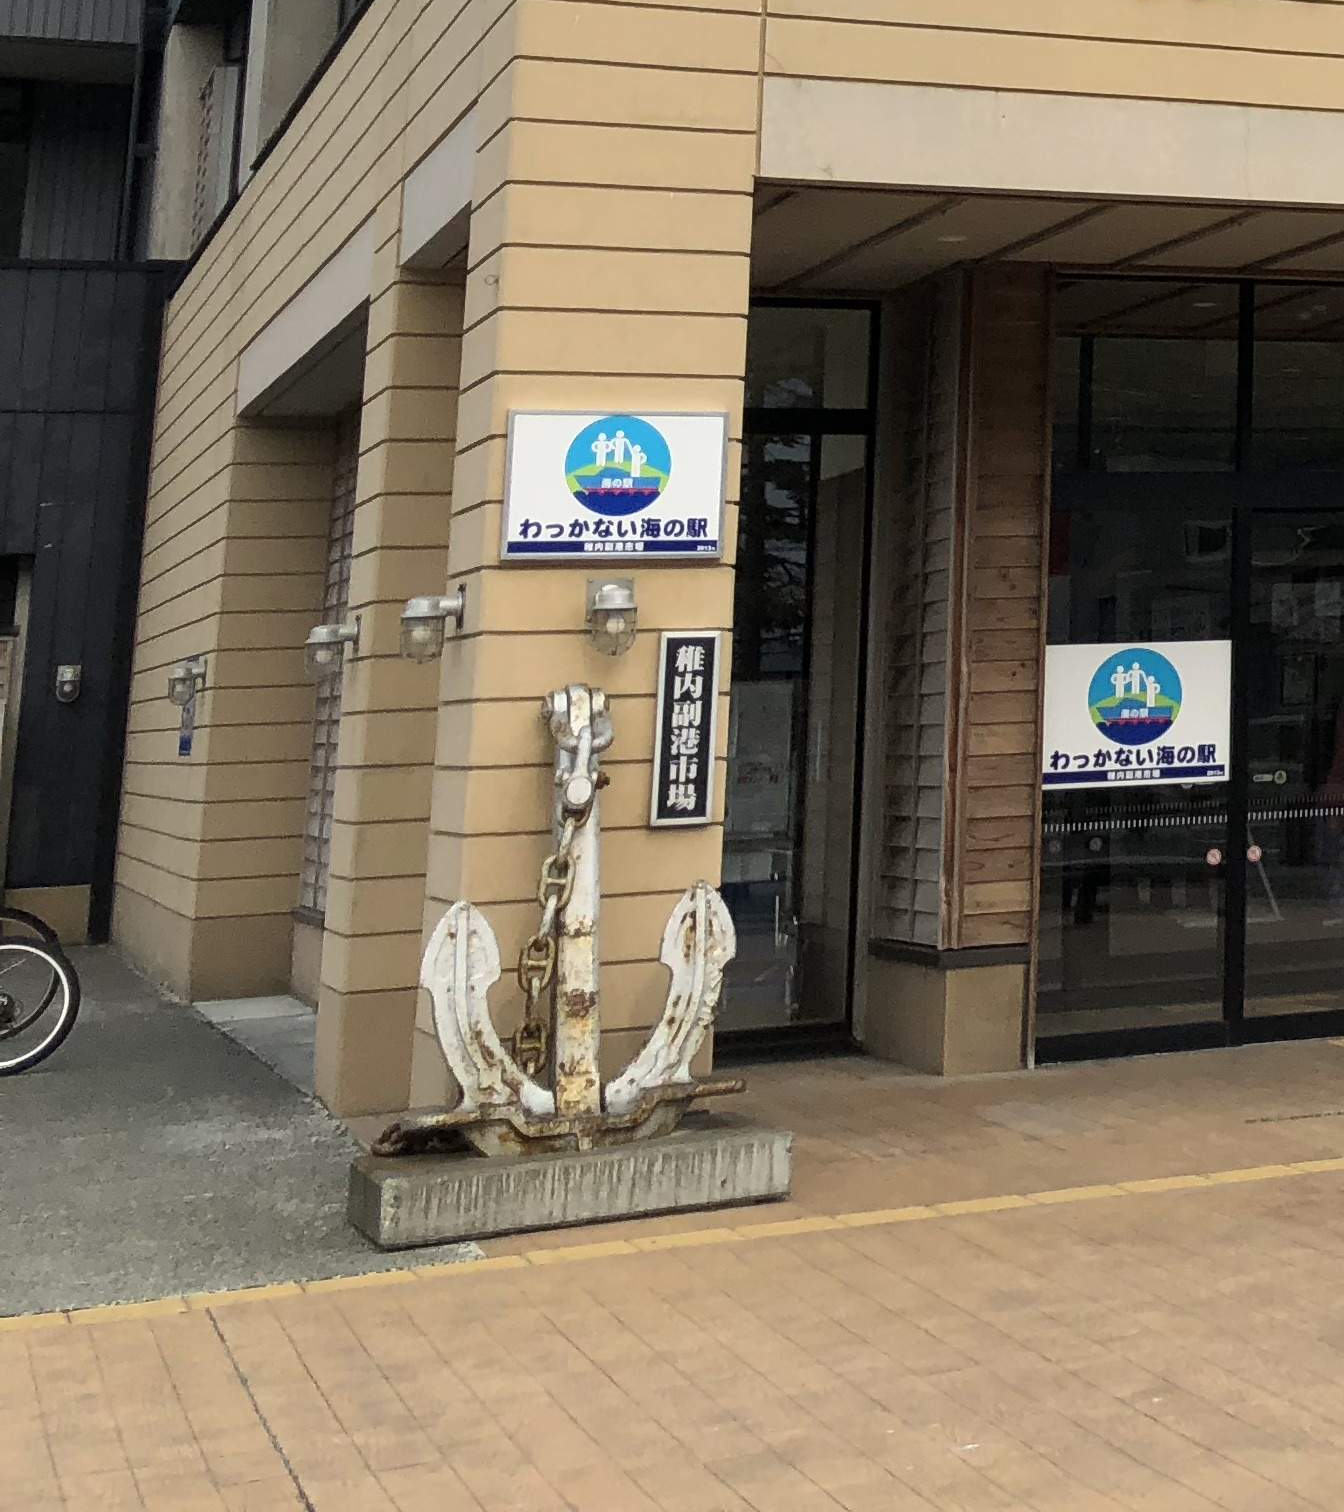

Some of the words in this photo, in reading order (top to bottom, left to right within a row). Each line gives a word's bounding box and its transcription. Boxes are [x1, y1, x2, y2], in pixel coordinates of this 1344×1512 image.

[519, 518, 708, 539] わっかない海の駅
[666, 645, 705, 811] 稚内副港市場
[1050, 743, 1217, 771] わっかない海の駅
